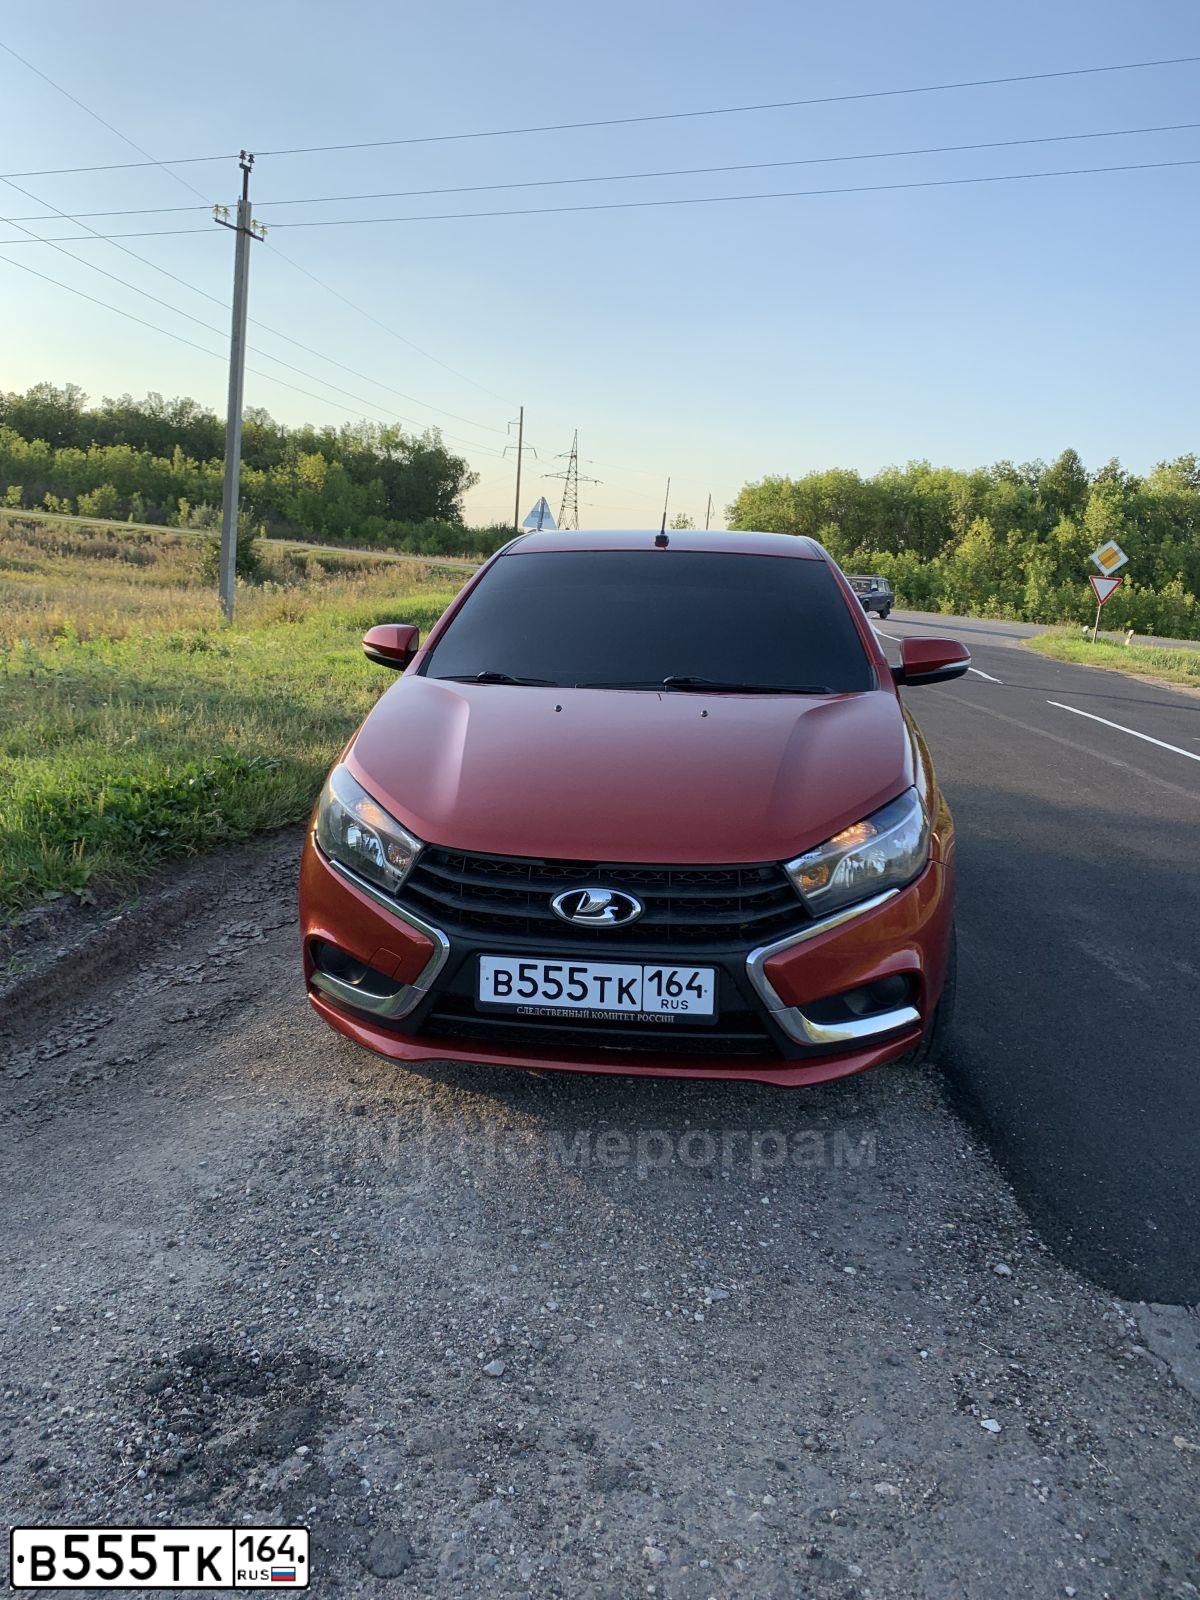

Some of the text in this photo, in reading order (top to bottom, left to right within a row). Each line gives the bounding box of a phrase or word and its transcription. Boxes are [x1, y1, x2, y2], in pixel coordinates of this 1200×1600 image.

[648, 969, 703, 998] 164
[660, 999, 690, 1010] RUS
[516, 1005, 675, 1024] СЛЕДСТВЕННЫЙ КОМИТЕТ РОССИИ
